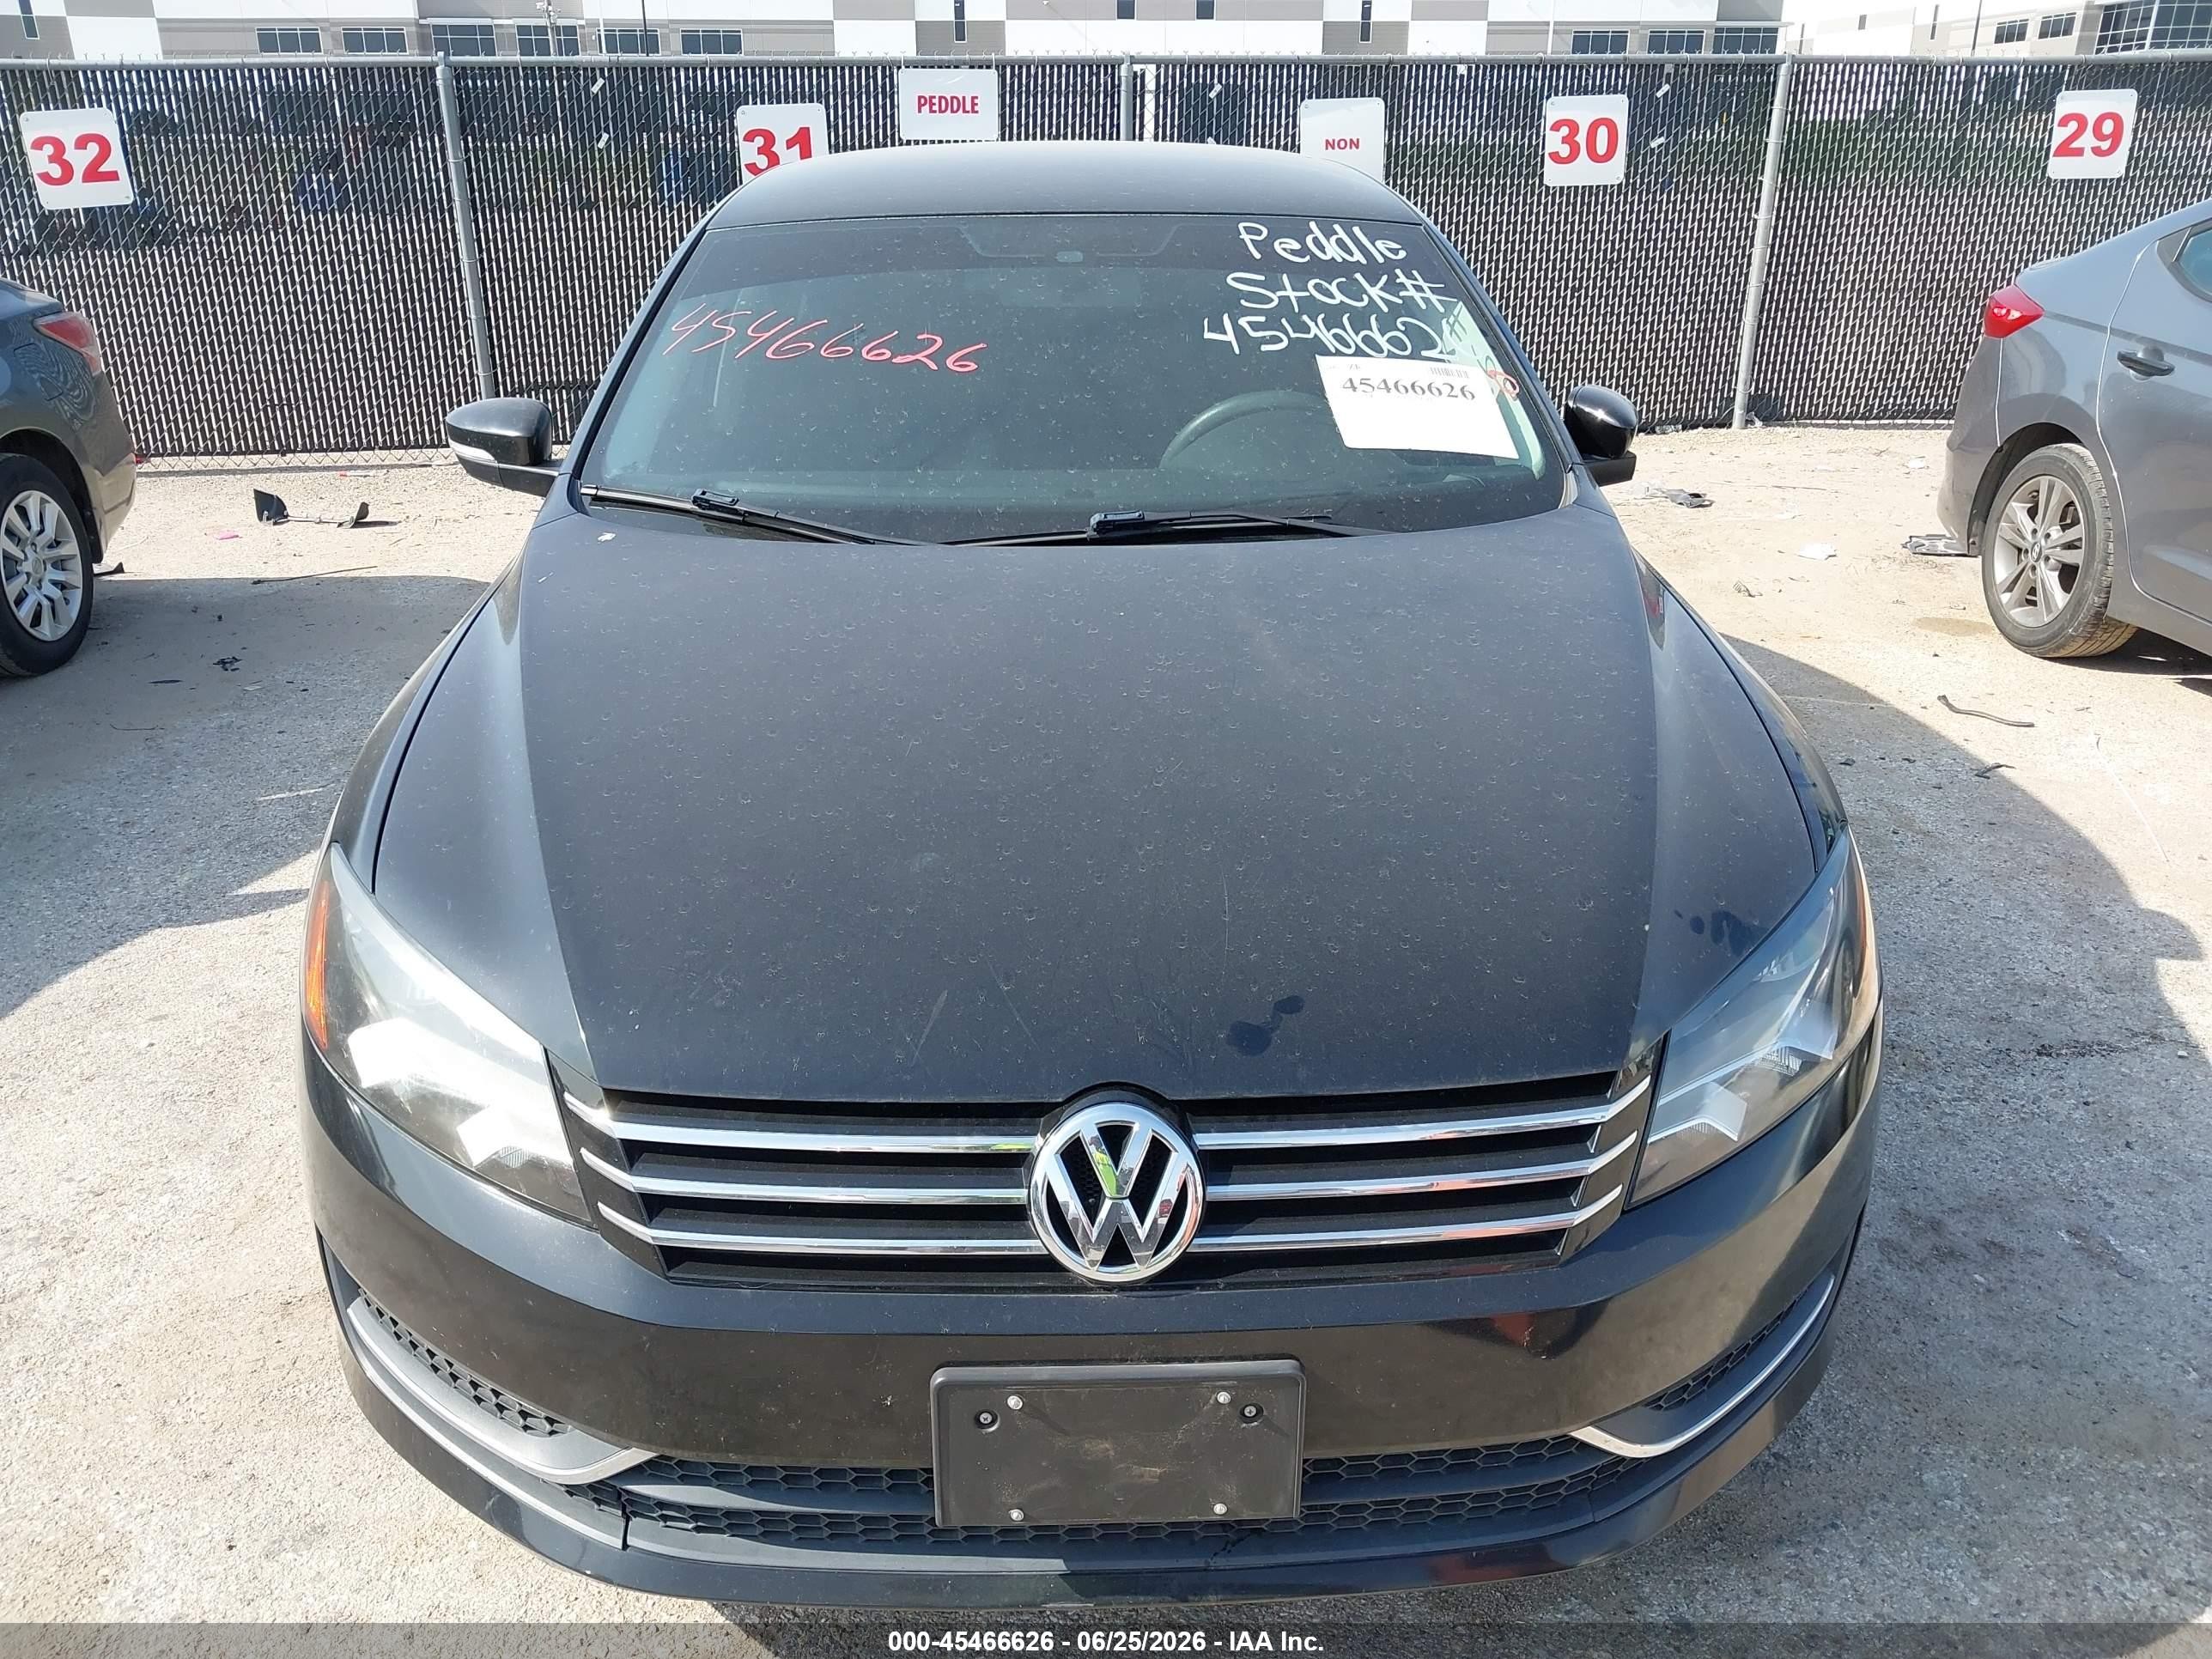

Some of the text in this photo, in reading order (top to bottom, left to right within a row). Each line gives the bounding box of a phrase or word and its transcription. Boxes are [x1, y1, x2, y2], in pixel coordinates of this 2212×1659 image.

[916, 94, 980, 114] PEDDLE
[742, 126, 813, 177] 31
[1324, 137, 1360, 151] NON
[1548, 117, 1620, 165] 30
[2052, 112, 2124, 158] 29
[30, 133, 120, 186] 32
[1238, 221, 1407, 264] Peddle
[662, 301, 988, 373] 45466626
[1340, 377, 1475, 401] 45466626
